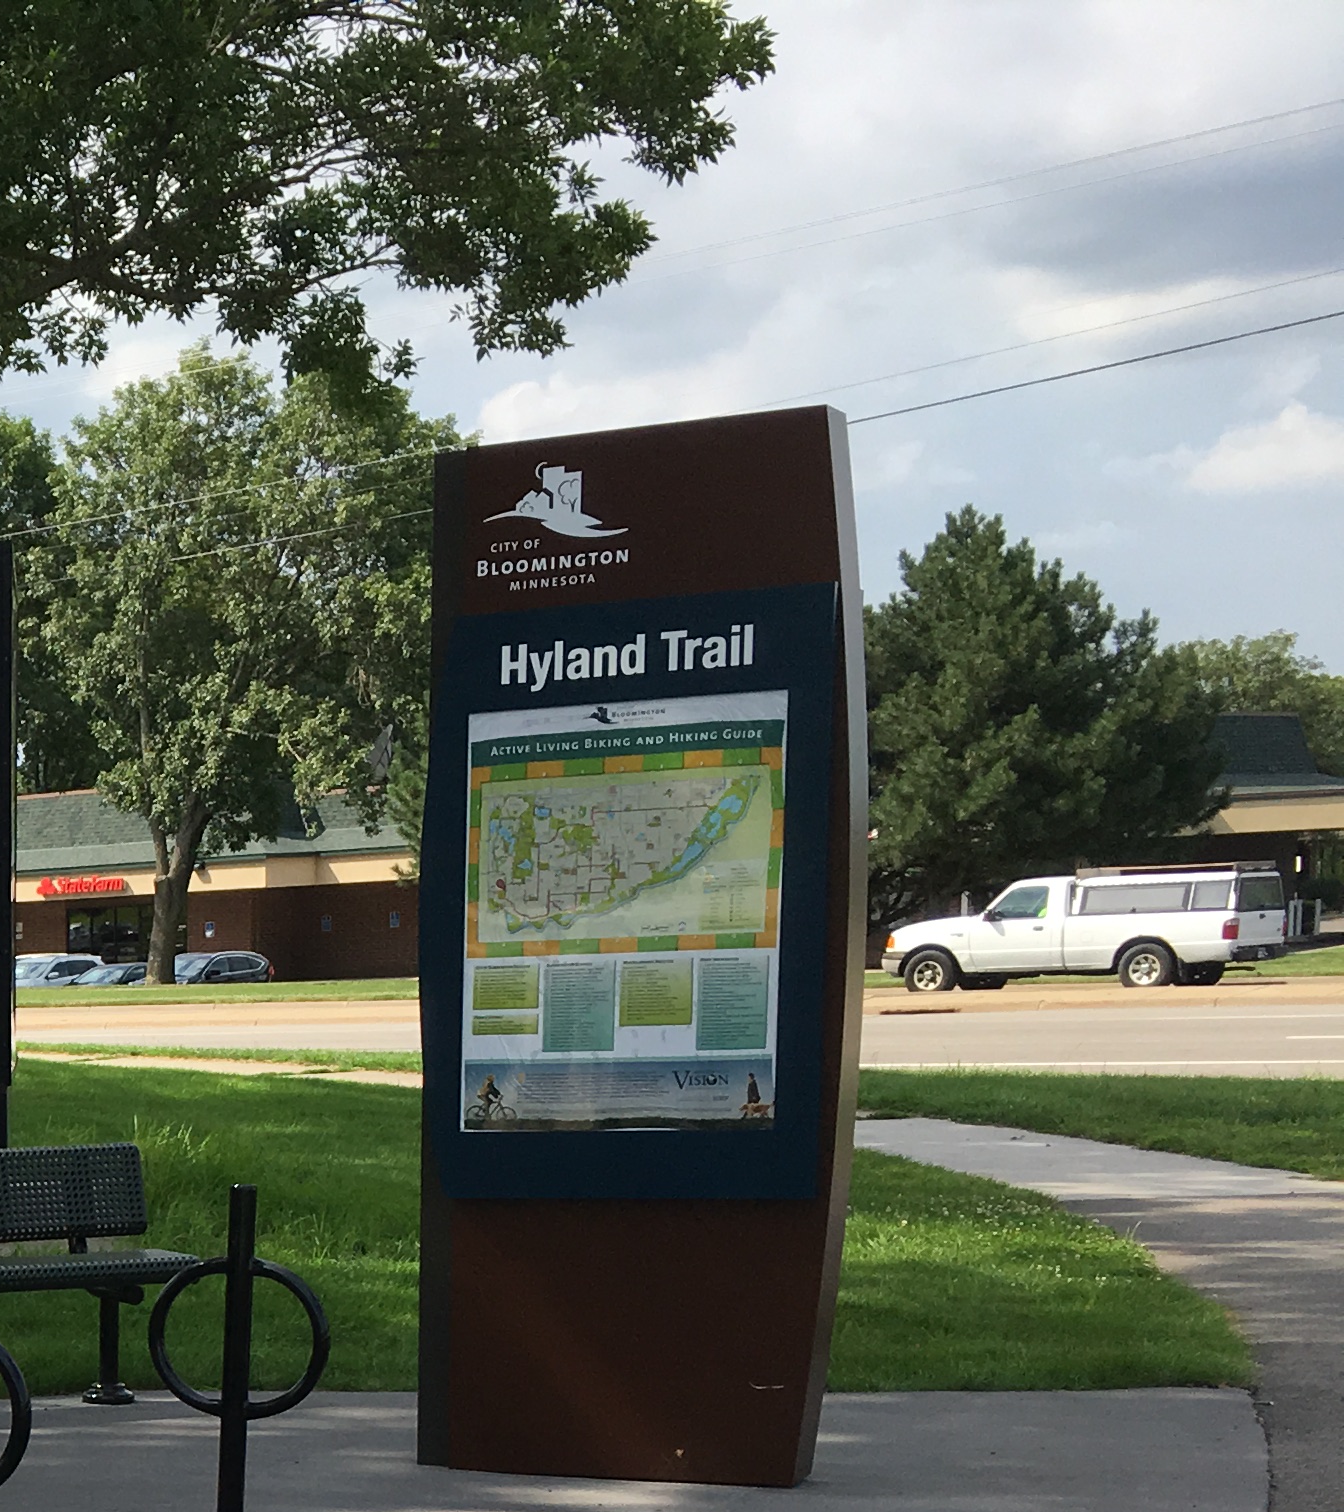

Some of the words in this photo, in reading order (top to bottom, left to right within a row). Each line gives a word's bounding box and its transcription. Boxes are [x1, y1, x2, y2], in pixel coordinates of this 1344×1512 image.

[490, 540, 520, 554] CITY
[523, 538, 542, 551] OF
[476, 549, 630, 578] BLOOMINGTON
[509, 574, 596, 592] MINNESOTA
[500, 634, 646, 693] Hyland
[661, 624, 755, 672] Trail
[490, 745, 531, 757] ACTIVE
[536, 741, 579, 753] LIVING
[584, 737, 631, 749] BIKING
[635, 735, 665, 746] AND
[669, 731, 718, 744] HIKING
[722, 728, 763, 741] GUIDE
[672, 1070, 729, 1090] VISION
